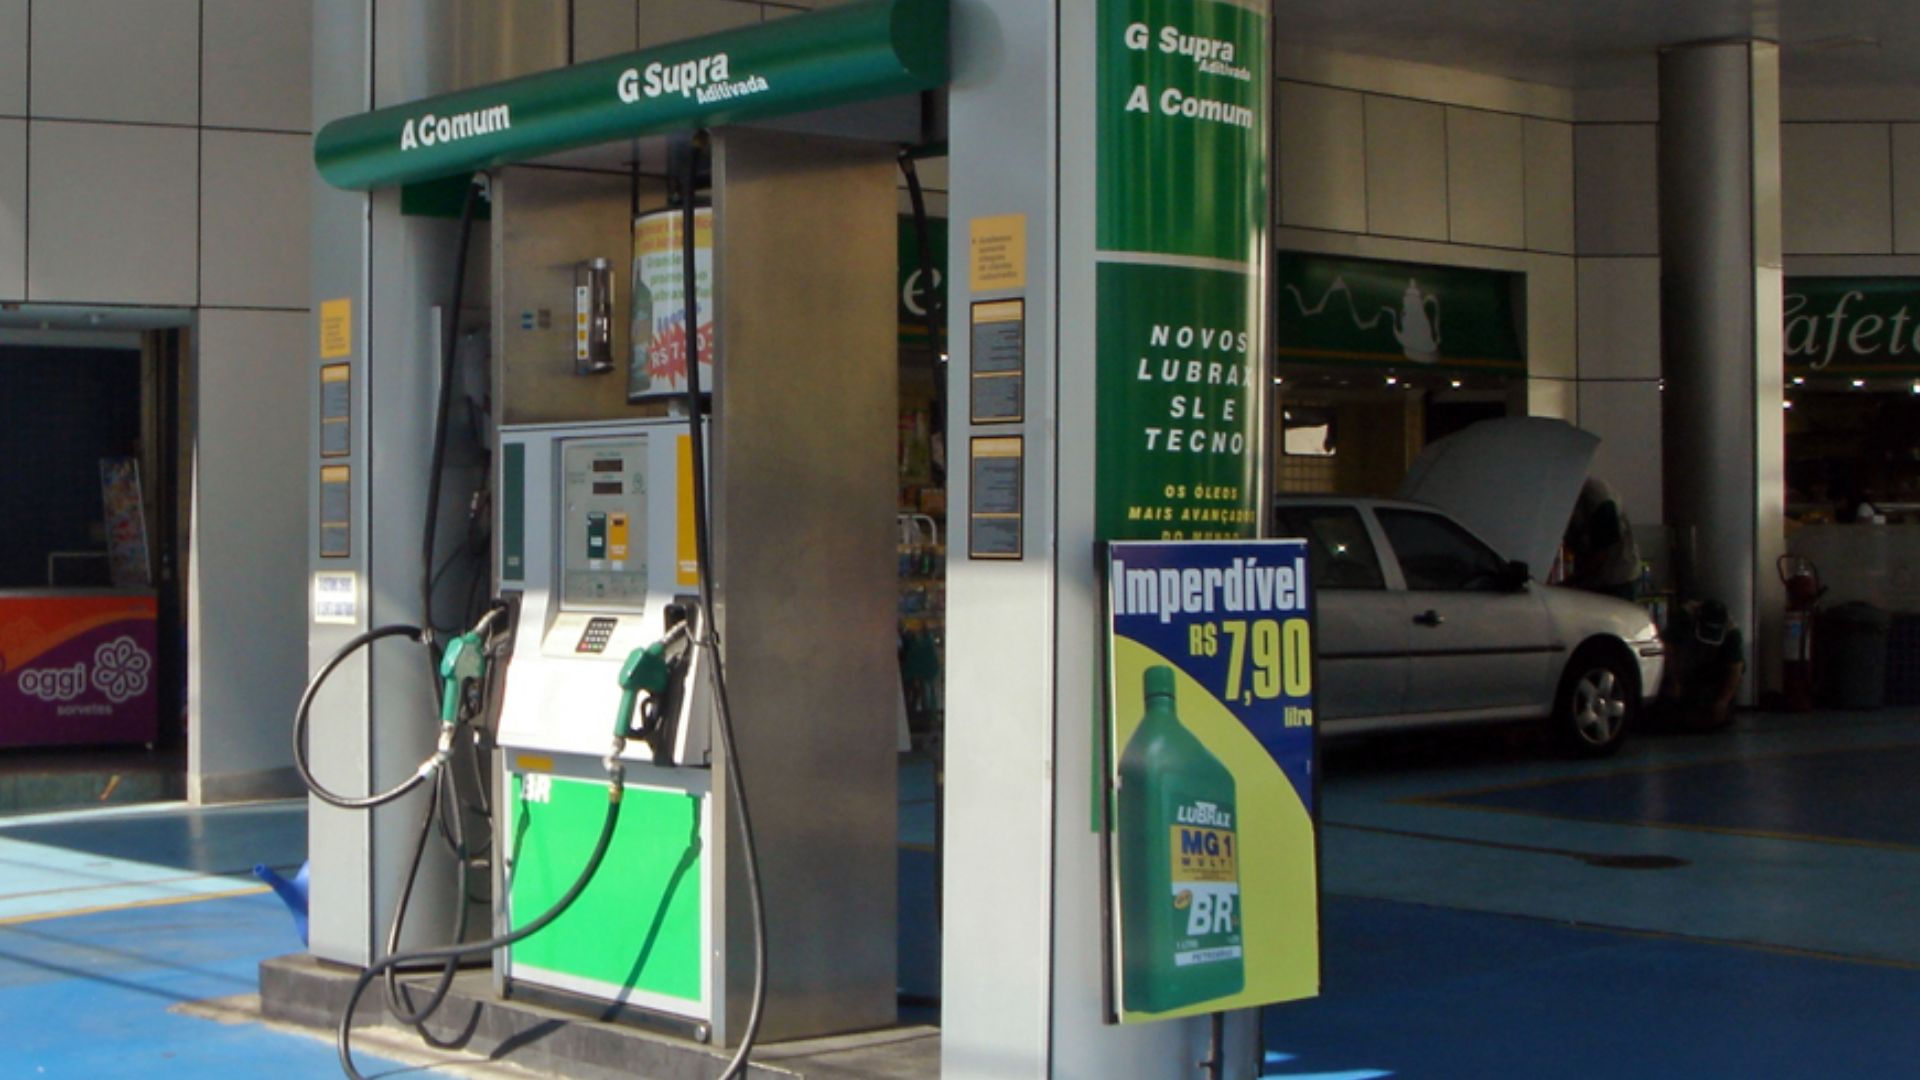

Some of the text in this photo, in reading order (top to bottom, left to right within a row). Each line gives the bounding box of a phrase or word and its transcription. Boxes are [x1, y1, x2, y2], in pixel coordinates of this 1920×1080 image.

[1125, 23, 1235, 63] G Supra
[617, 52, 730, 104] G Supra
[696, 75, 768, 105] Aditivada
[1125, 85, 1254, 129] A Comum
[401, 103, 511, 152] A Comum
[1150, 325, 1249, 354] NOVOS
[1783, 289, 1920, 371] afet
[1137, 358, 1253, 388] LUBRAX
[1170, 395, 1237, 421] SL E
[1144, 428, 1244, 455] TECNO
[1164, 482, 1238, 501] OS ÓLEOS
[1128, 506, 1174, 522] MAIS
[1111, 556, 1307, 624] Imperdível
[1189, 617, 1312, 707] R$ 7,90
[18, 661, 87, 701] oggi
[56, 702, 113, 717] sorvetes
[1284, 705, 1313, 729] litro
[1177, 801, 1231, 828] LUBRAX
[1180, 829, 1233, 858] MG 1
[1187, 886, 1234, 937] BR
